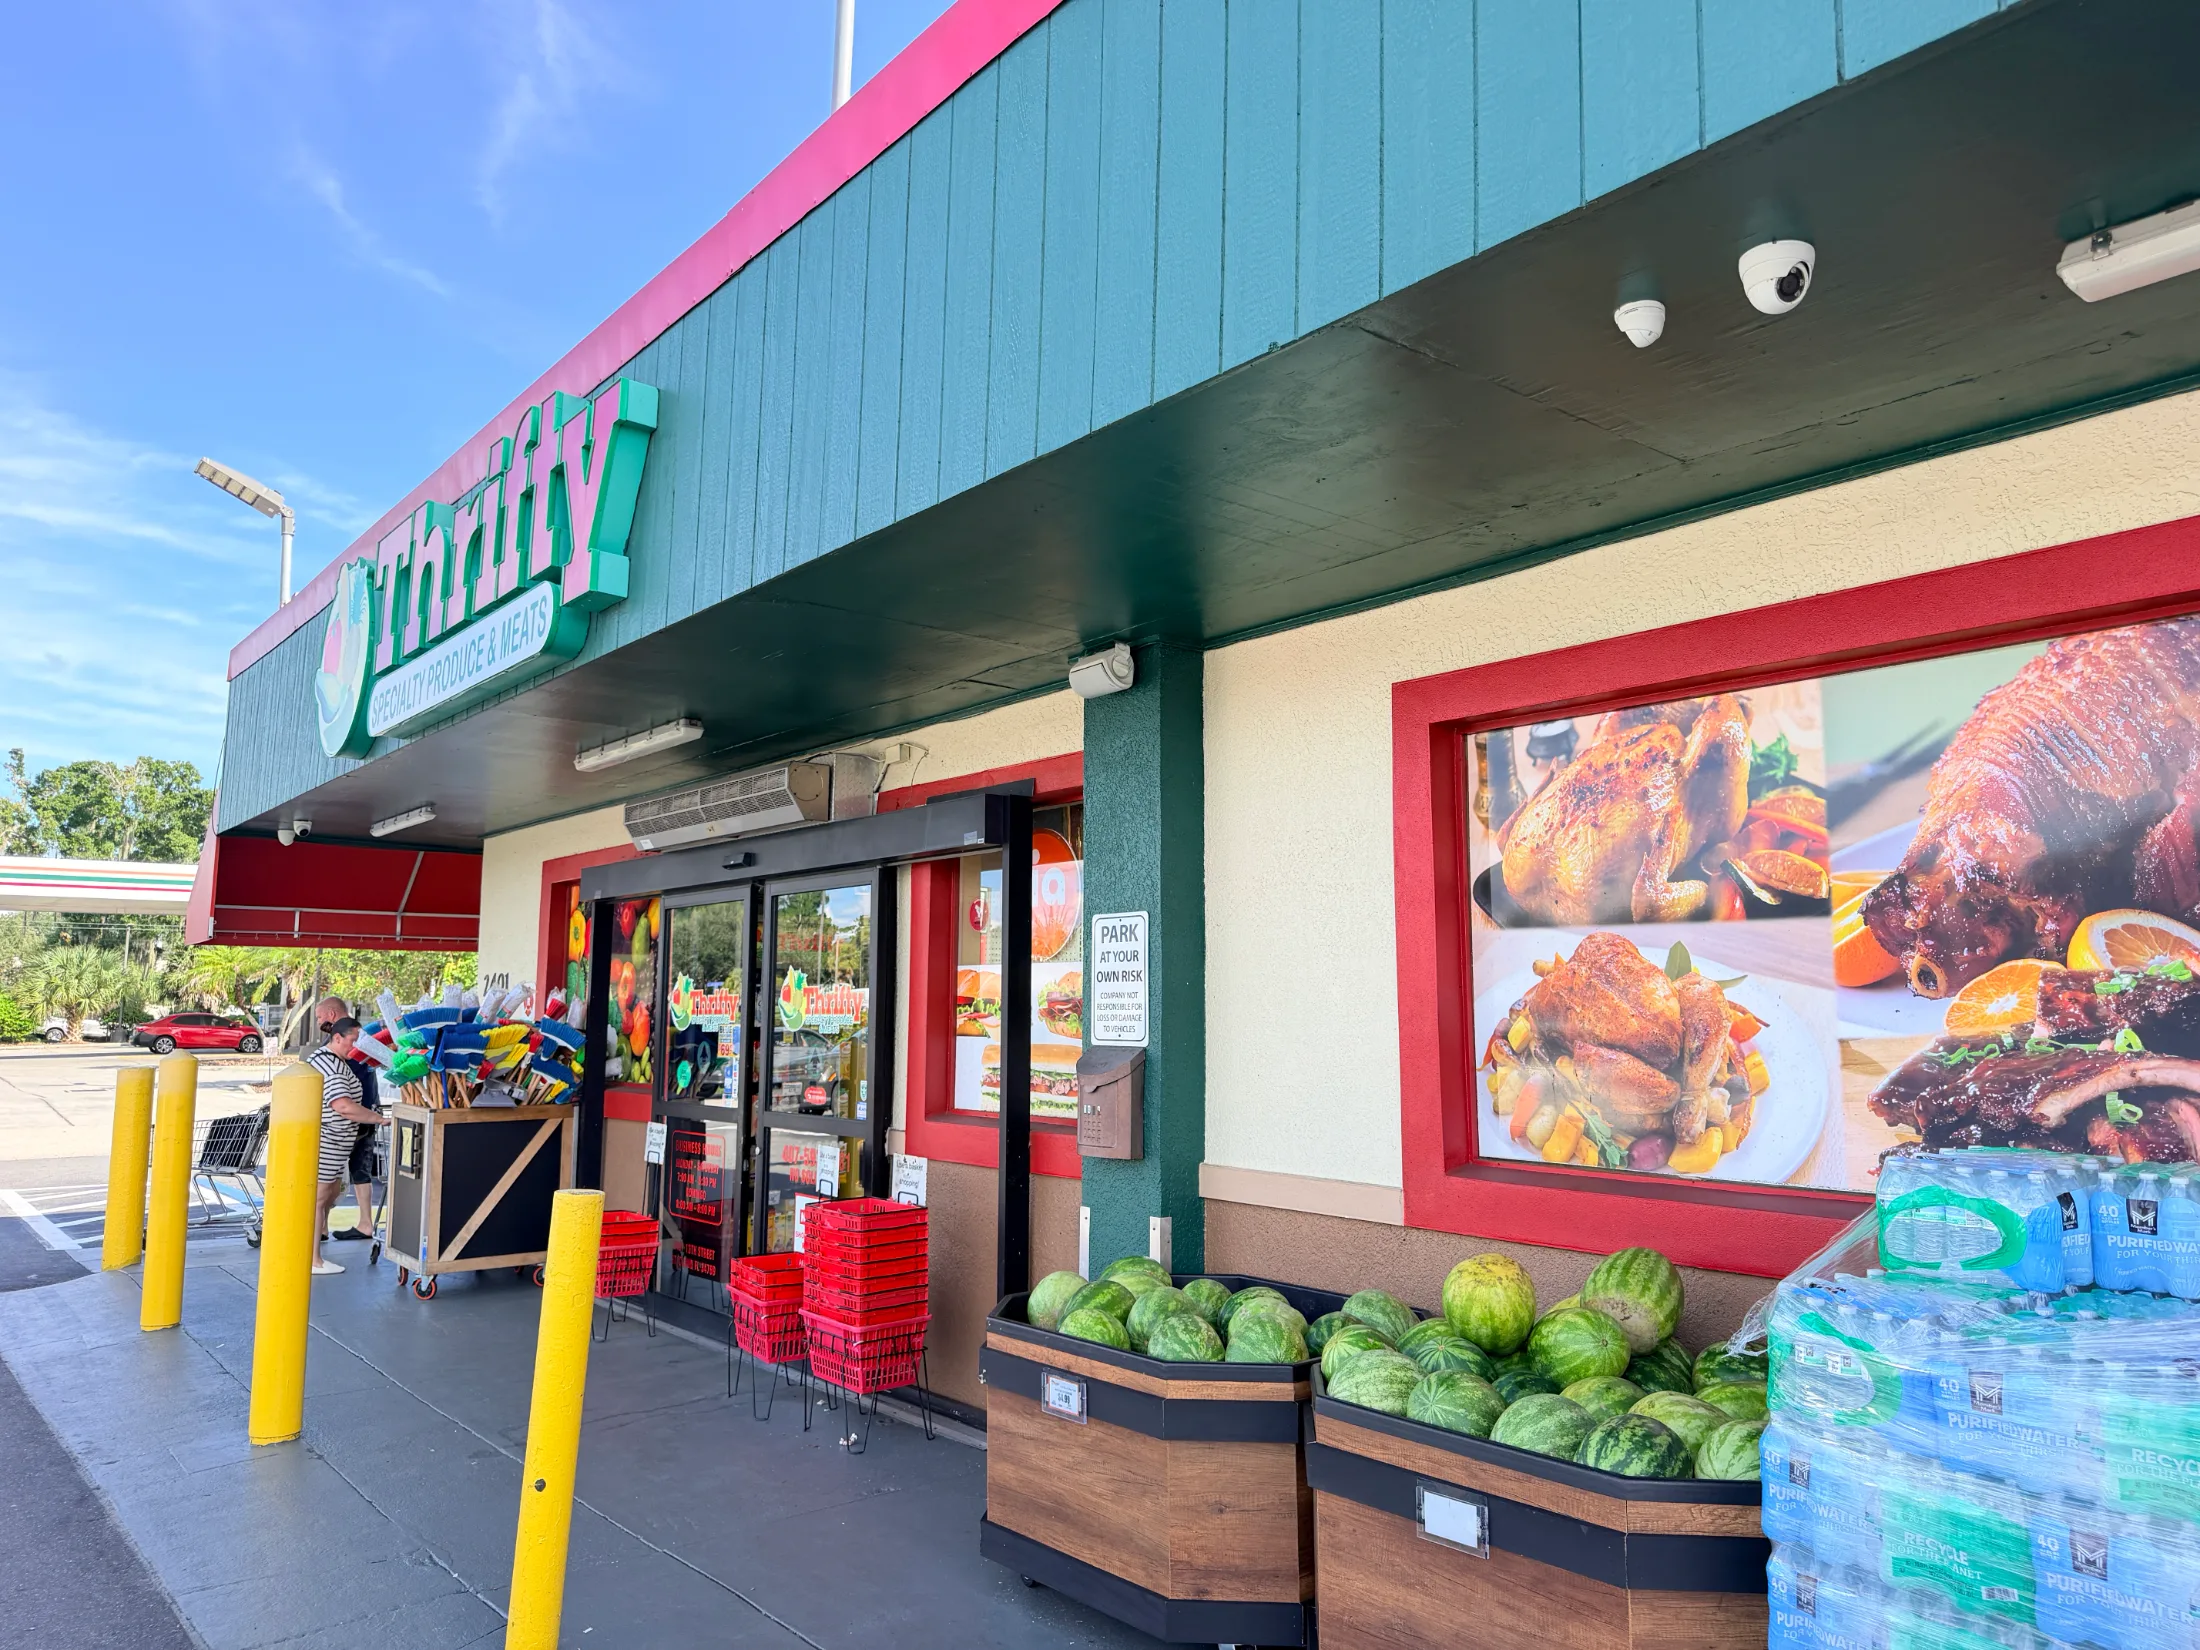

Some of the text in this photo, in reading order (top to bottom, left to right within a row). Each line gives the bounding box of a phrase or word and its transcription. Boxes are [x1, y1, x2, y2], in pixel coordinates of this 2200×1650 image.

[374, 377, 634, 675] Thrifty
[371, 595, 547, 728] SPECIALTY PRODUCE & MEATS
[1101, 923, 1139, 944] PARK
[1100, 949, 1139, 963] AT YOUR
[1096, 970, 1143, 983] OWN RISK
[803, 984, 864, 1022] Thrifty
[1126, 991, 1139, 999] NOT
[690, 987, 739, 1022] Thrifty
[1097, 1003, 1142, 1011] RESPONSIBLE FOR
[1097, 1014, 1109, 1022] LOSS
[1118, 1013, 1142, 1022] DAMAGE
[1111, 1025, 1136, 1033] VEHICLES
[675, 1139, 702, 1155] BUSINESS
[2099, 1205, 2119, 1218] 40
[2107, 1235, 2173, 1252] PURIFIED
[2116, 1250, 2140, 1259] FOR
[1939, 1377, 1959, 1393] 40
[1958, 1430, 1983, 1441] FOR
[2018, 1427, 2080, 1450] WATER
[1775, 1501, 1797, 1512] FOR
[1903, 1531, 1969, 1566] RECYCLE
[2037, 1534, 2060, 1552] 40
[2057, 1593, 2086, 1606] FOR
[2122, 1595, 2196, 1627] WATER
